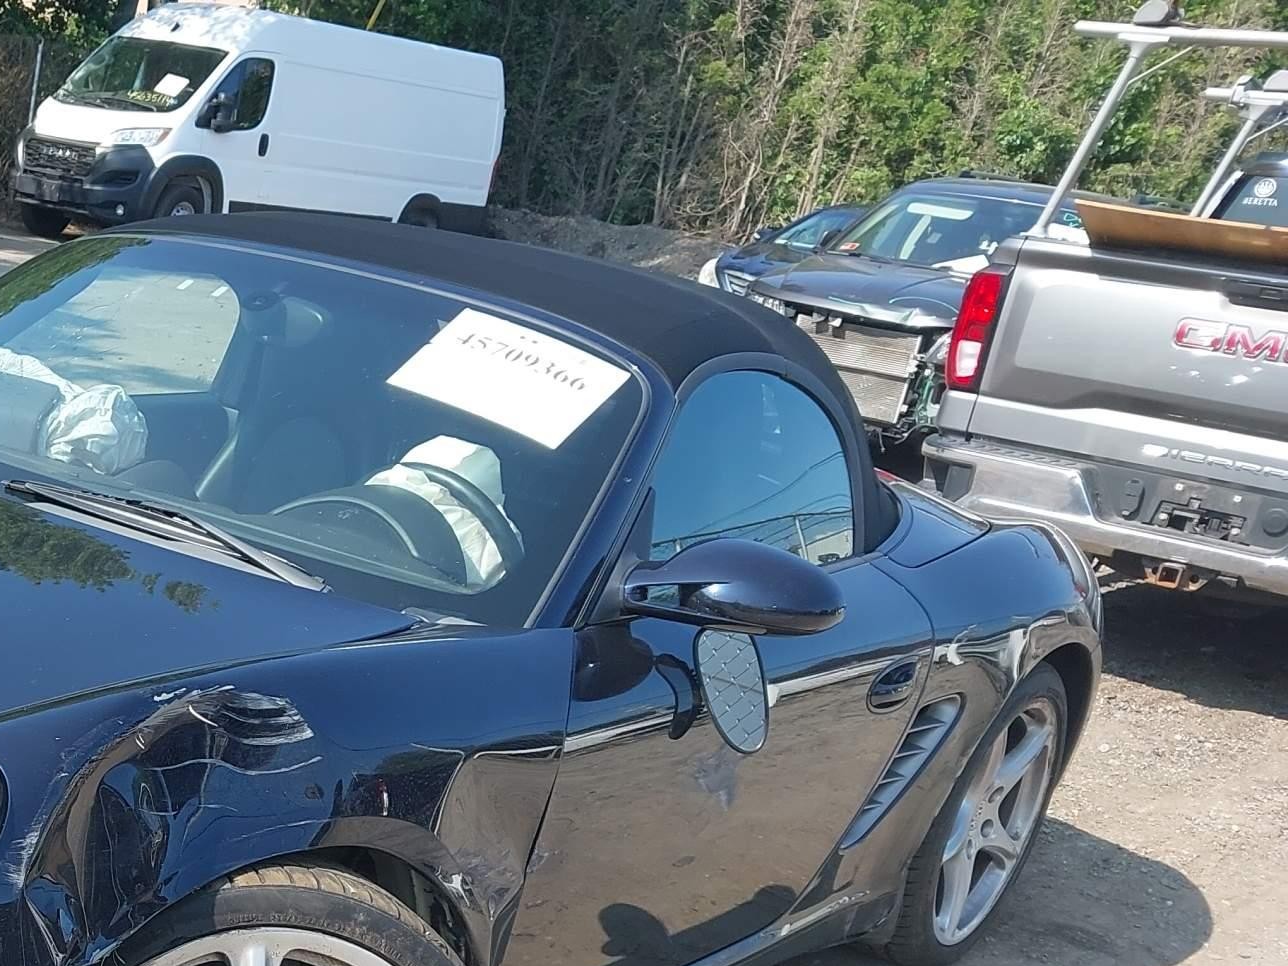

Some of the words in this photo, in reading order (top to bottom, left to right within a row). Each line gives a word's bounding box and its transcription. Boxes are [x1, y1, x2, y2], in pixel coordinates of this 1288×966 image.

[1242, 197, 1278, 207] BERETTA
[1173, 316, 1288, 364] GM
[456, 333, 586, 391] 45709366
[1142, 443, 1288, 481] IERRA
